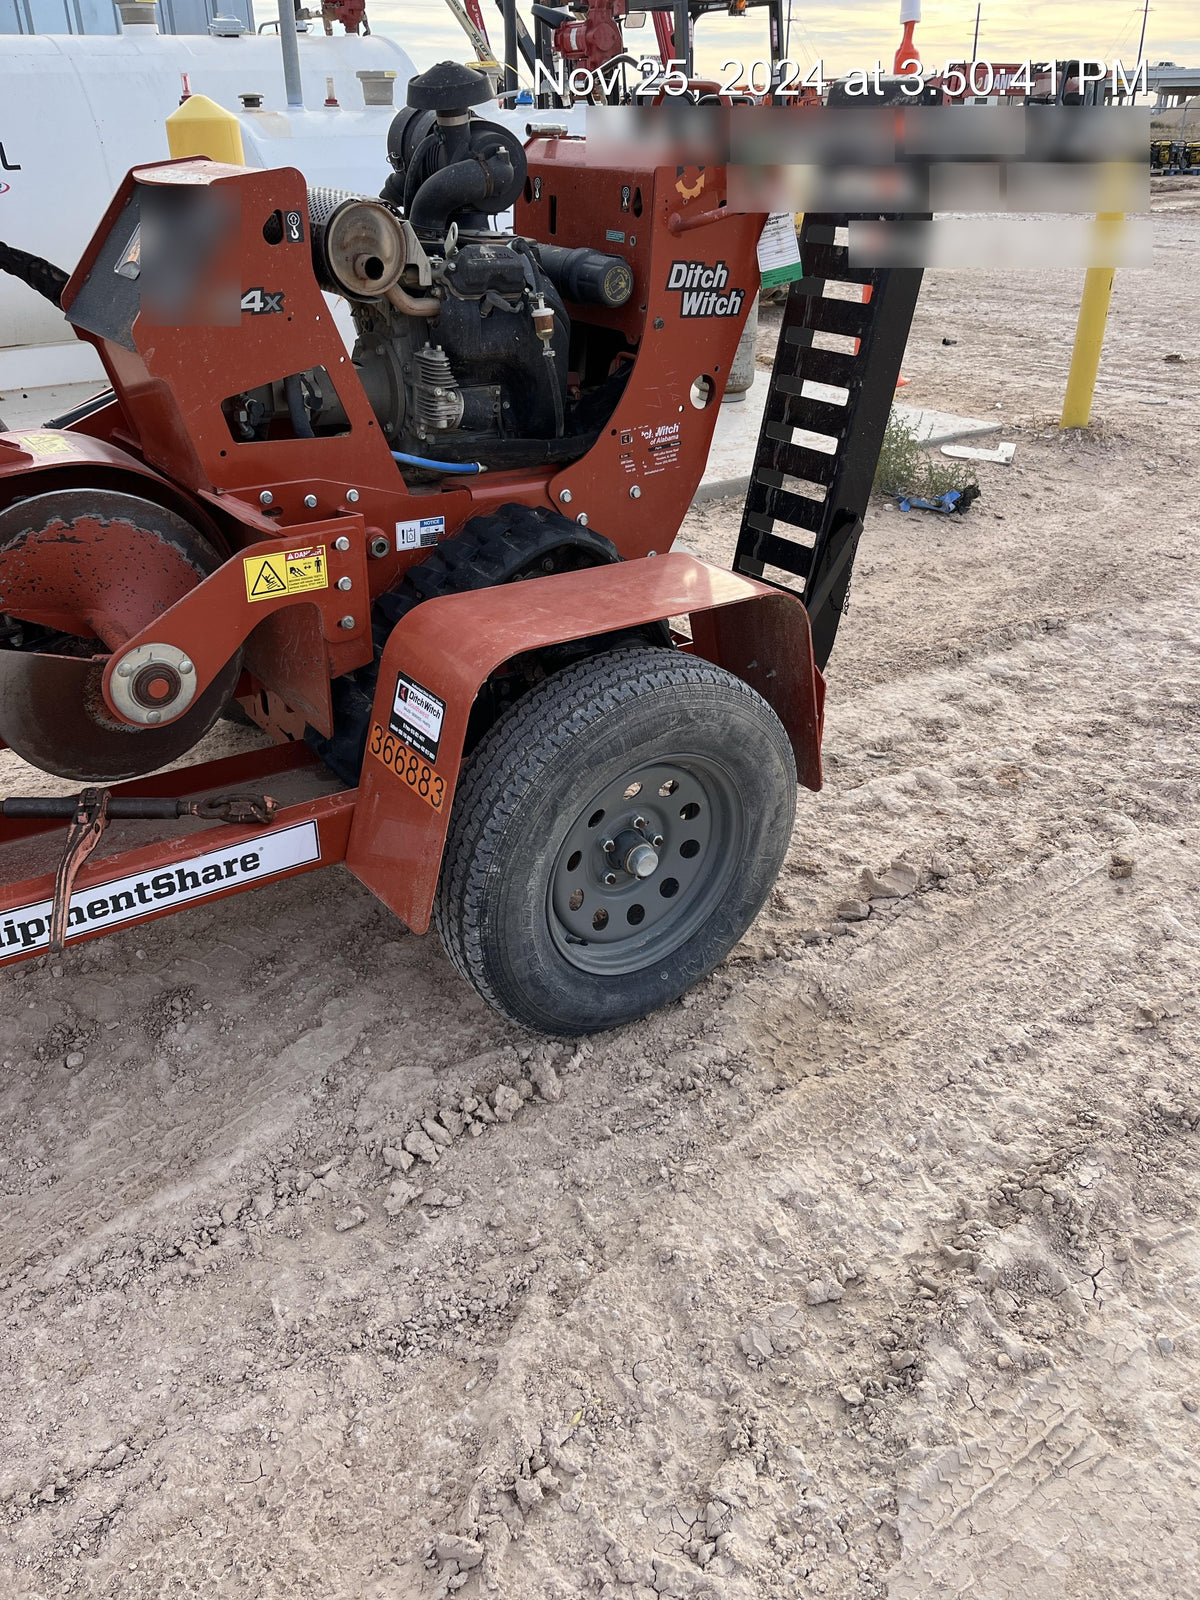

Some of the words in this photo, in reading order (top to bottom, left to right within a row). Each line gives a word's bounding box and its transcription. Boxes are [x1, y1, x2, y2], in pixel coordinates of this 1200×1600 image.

[667, 262, 729, 289] Ditch
[682, 291, 742, 316] Witch
[371, 725, 444, 808] 366883
